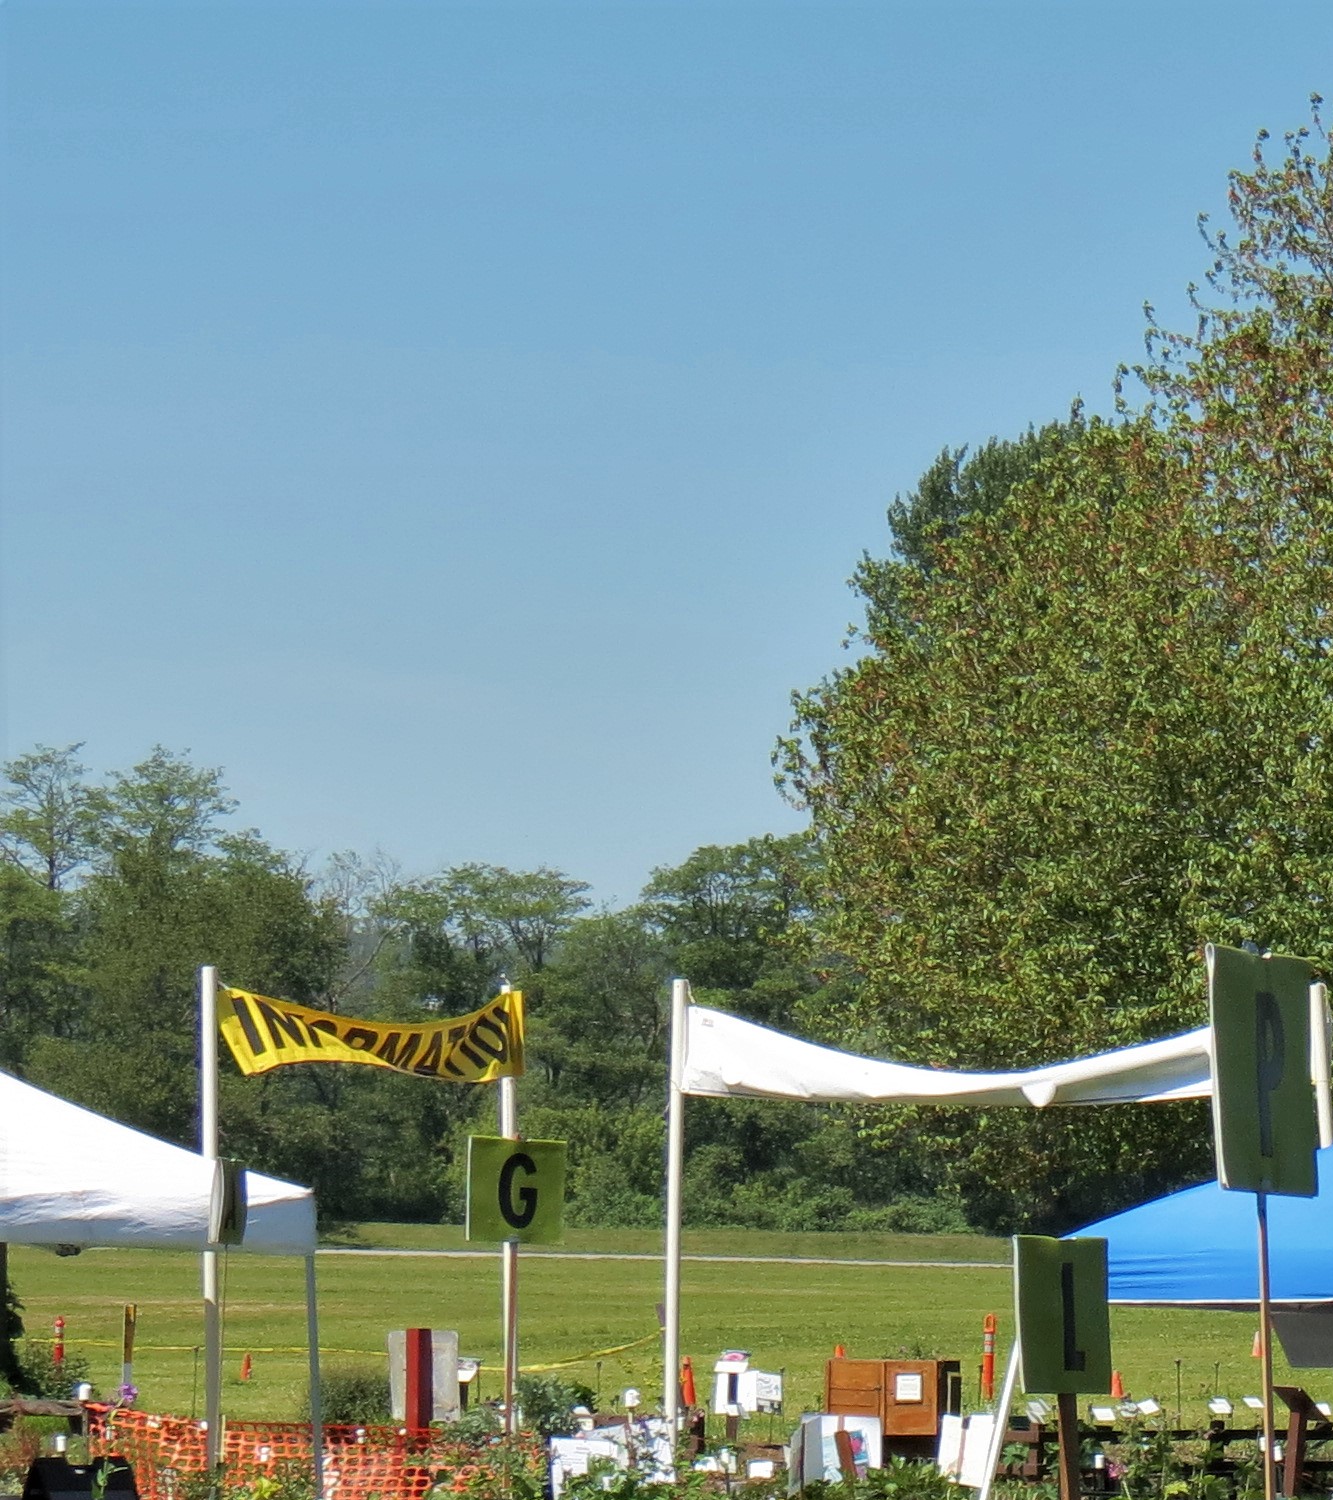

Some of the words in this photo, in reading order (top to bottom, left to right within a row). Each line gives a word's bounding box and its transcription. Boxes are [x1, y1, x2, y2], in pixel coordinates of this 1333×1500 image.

[231, 995, 510, 1077] INRMATIO
[1255, 991, 1286, 1158] P
[498, 1152, 538, 1229] G
[1061, 1261, 1087, 1373] L
